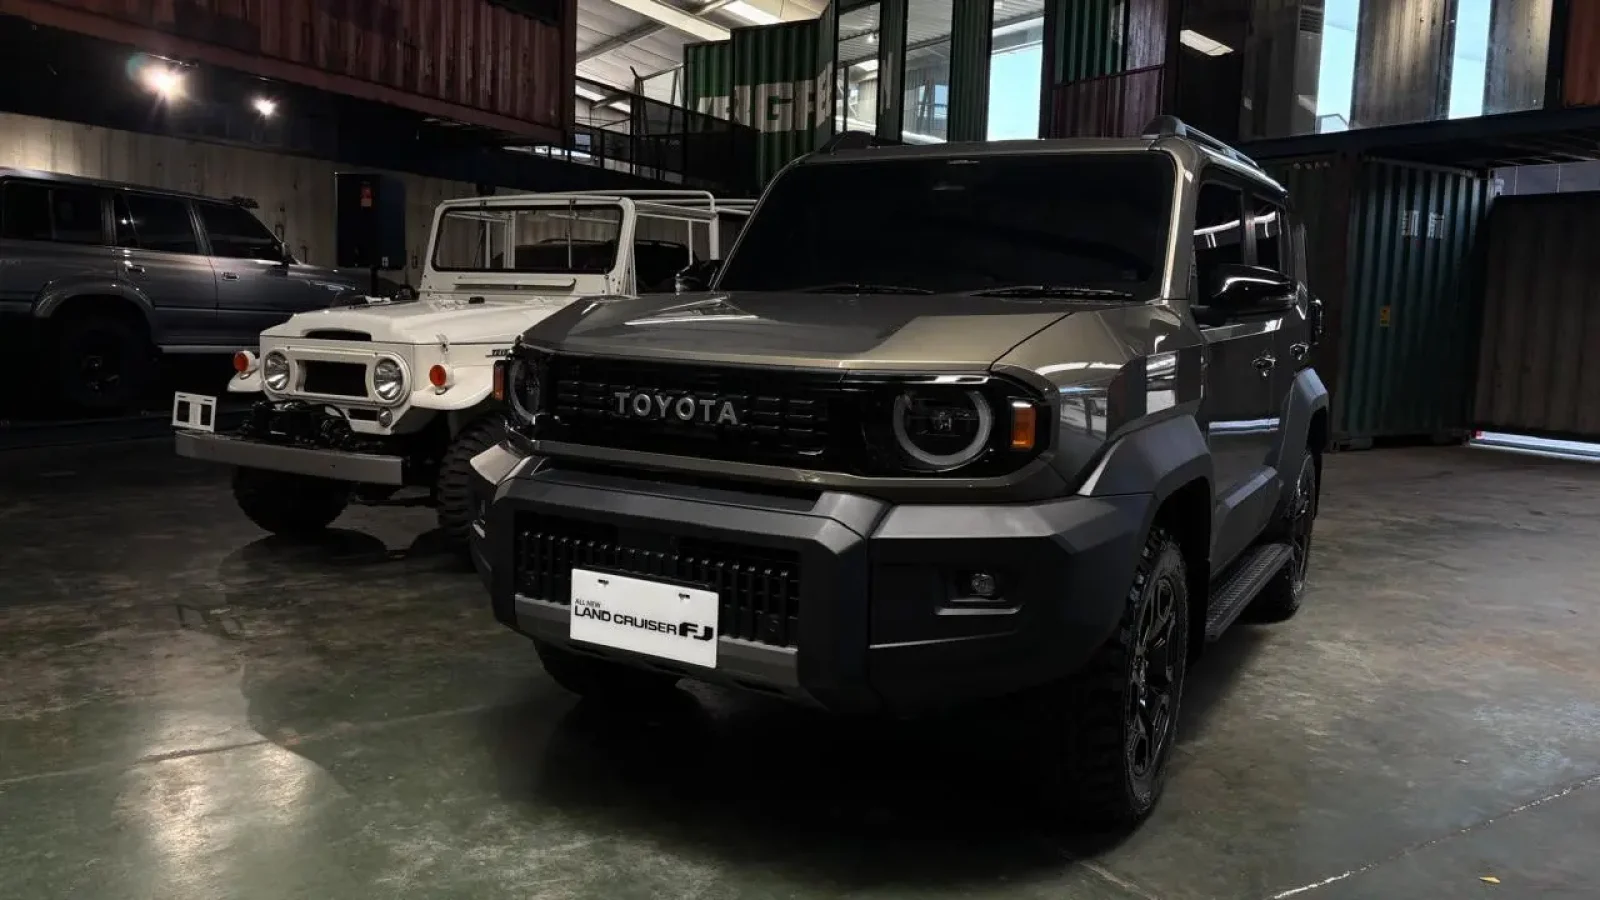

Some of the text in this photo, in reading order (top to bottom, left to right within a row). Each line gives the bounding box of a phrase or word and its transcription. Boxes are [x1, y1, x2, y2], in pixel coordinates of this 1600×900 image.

[614, 391, 738, 425] TOYOTA
[575, 598, 601, 608] ALL NEW
[574, 605, 713, 641] LAND CRUISER FJ
